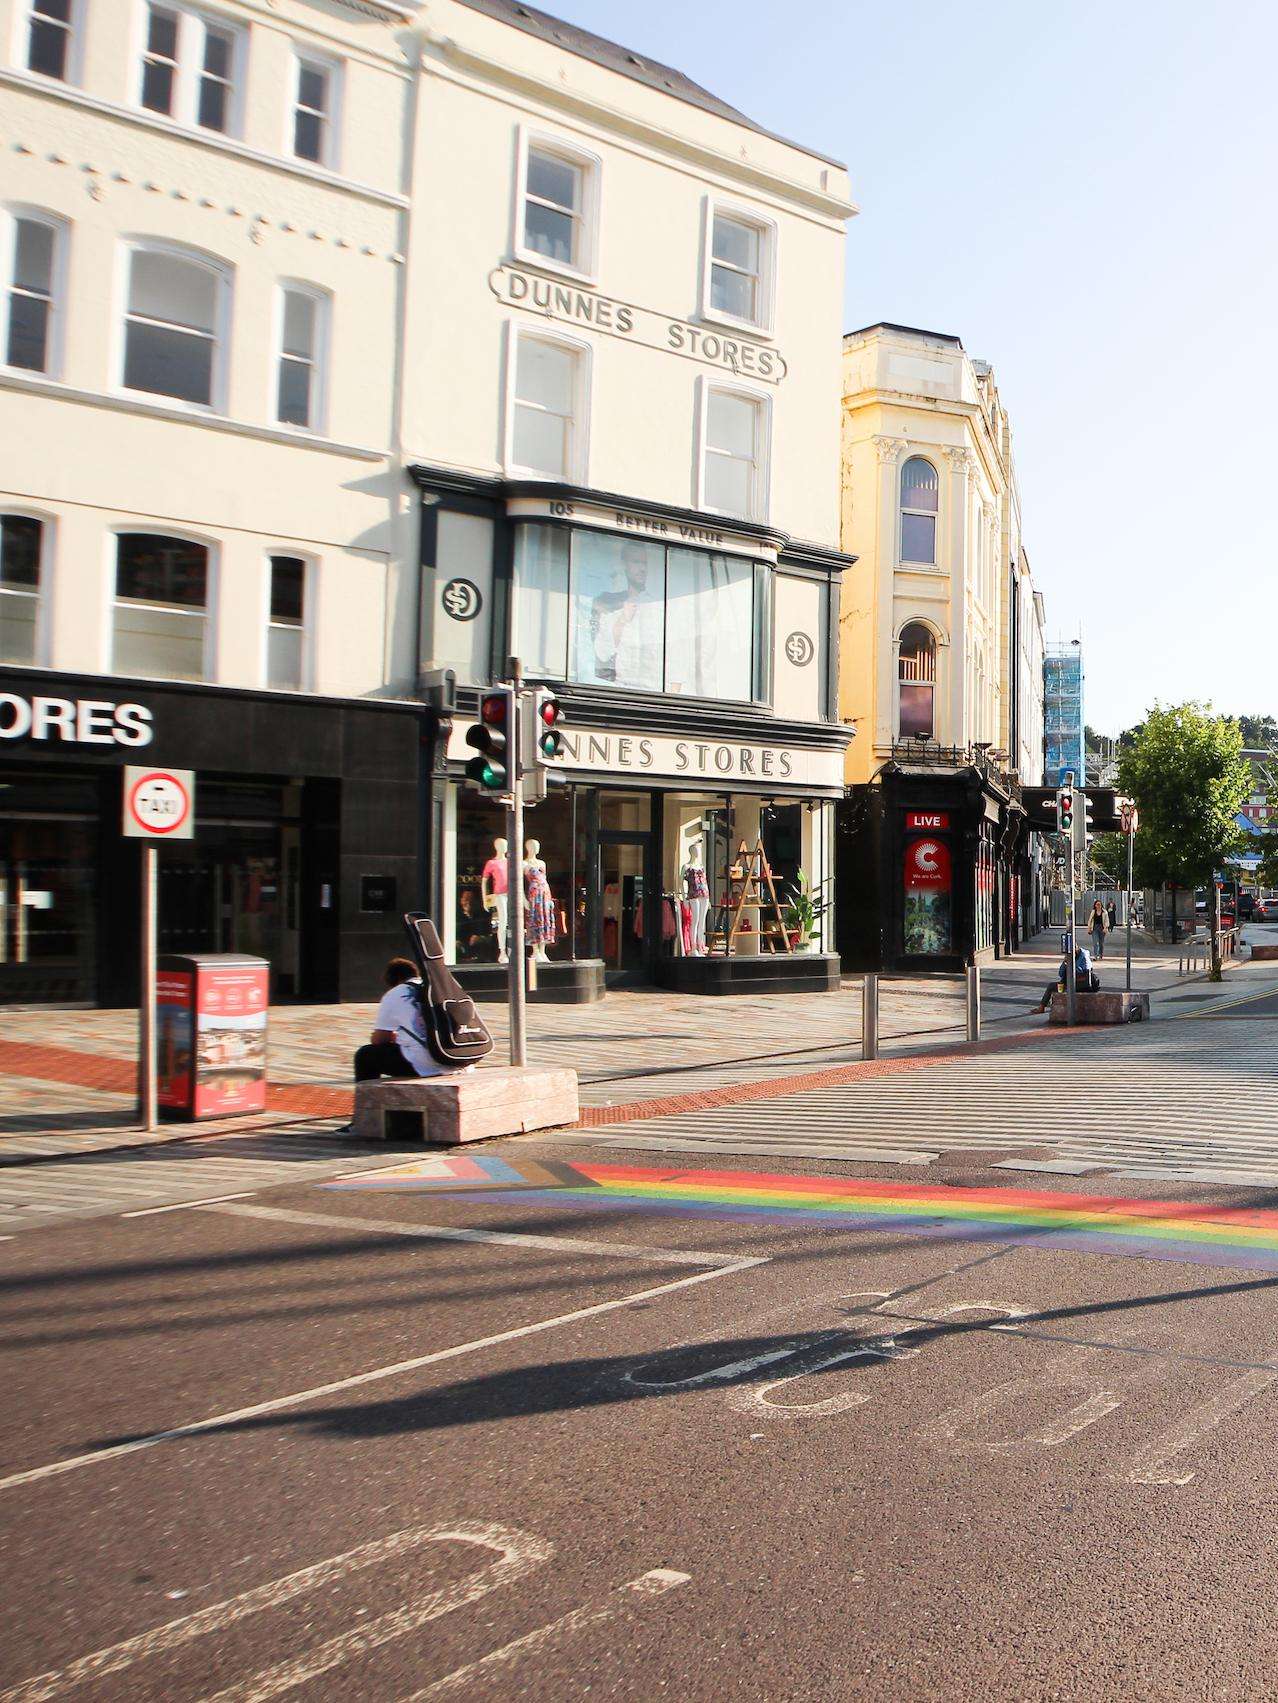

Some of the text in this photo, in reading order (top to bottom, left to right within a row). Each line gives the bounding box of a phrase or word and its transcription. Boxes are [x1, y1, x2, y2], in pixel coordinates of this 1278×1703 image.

[508, 273, 774, 376] DUNNES STORES
[549, 502, 574, 516] 105
[616, 512, 724, 546] BETTER VALUE
[675, 742, 793, 777] STORES
[914, 816, 941, 826] LIVE
